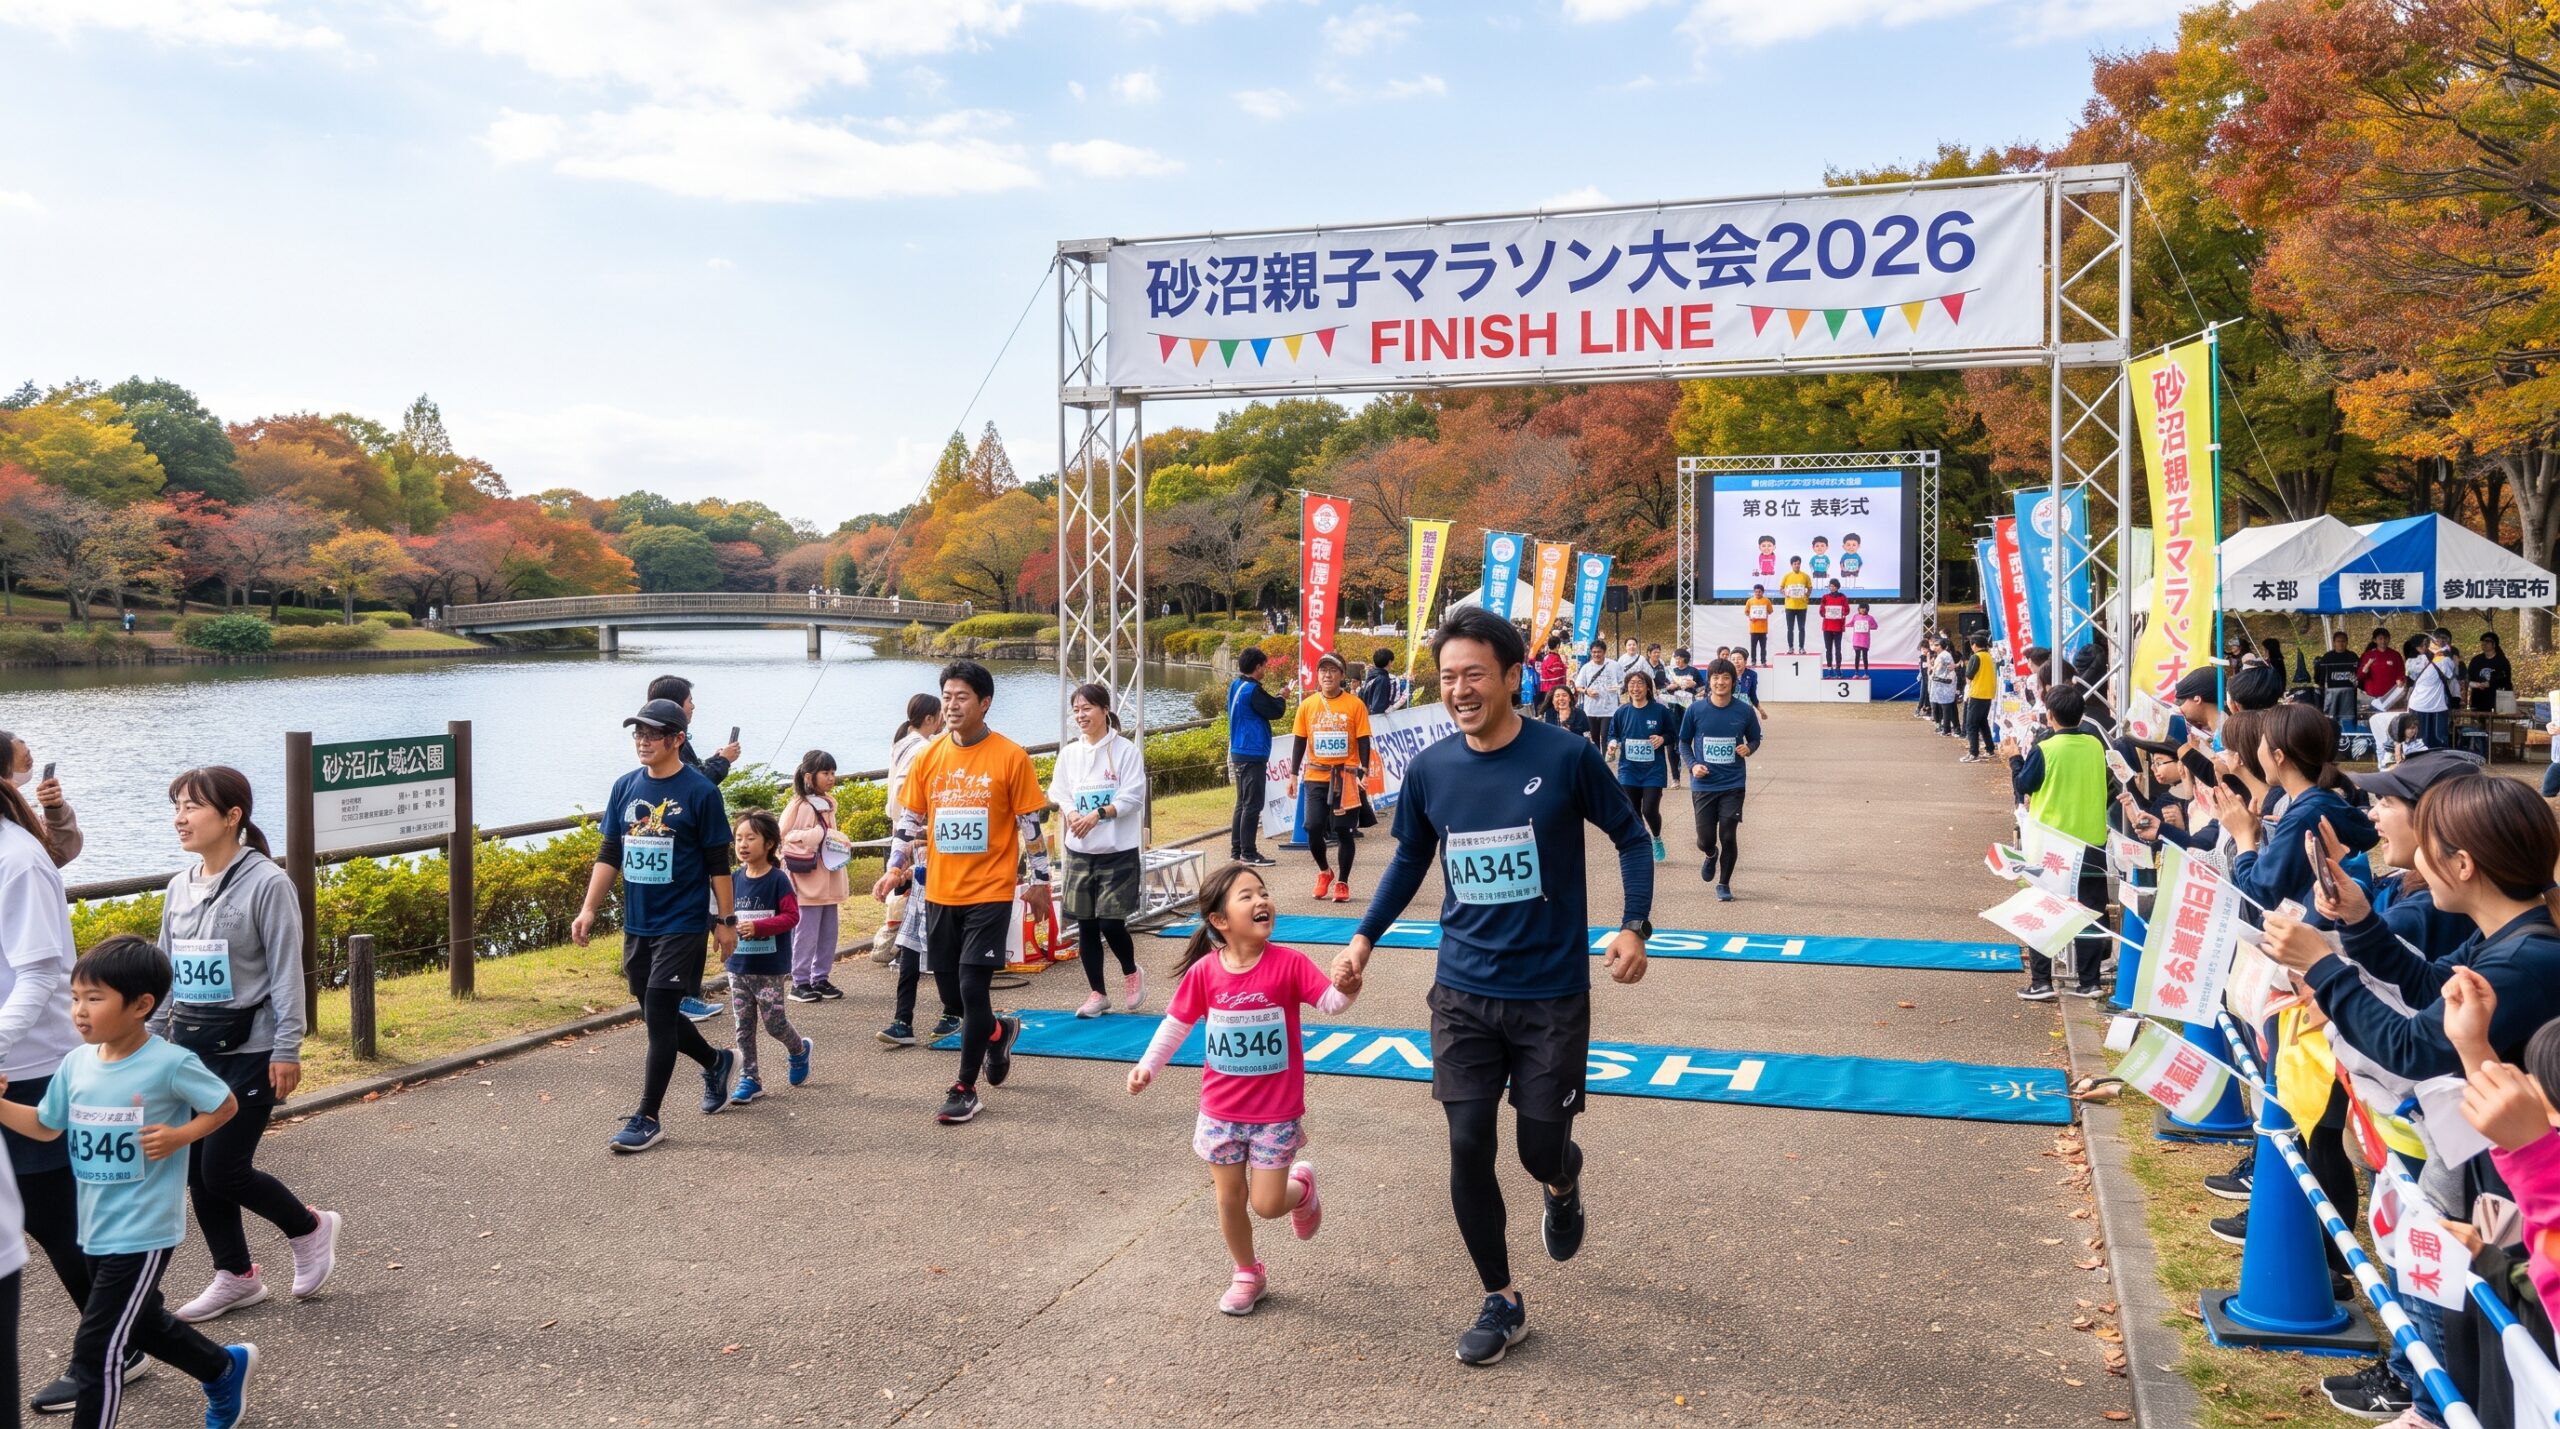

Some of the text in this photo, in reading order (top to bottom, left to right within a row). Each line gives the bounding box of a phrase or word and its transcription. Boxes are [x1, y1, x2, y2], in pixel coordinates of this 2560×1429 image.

[1145, 210, 1976, 318] 砂沼親子マラソン大会2026
[1371, 303, 1714, 364] FINISH LINE
[1742, 496, 1870, 517] 第8位 表彰式
[2252, 580, 2299, 601] 本部
[2358, 578, 2405, 600] 救護
[2442, 578, 2550, 600] 参加賞配布
[1792, 661, 1799, 677] 1
[1837, 682, 1850, 698] 3
[322, 744, 445, 784] 砂沼広域公園
[624, 850, 669, 872] A345
[1451, 850, 1534, 886] AA345
[173, 959, 225, 986] A346
[1207, 1028, 1283, 1058] AA346
